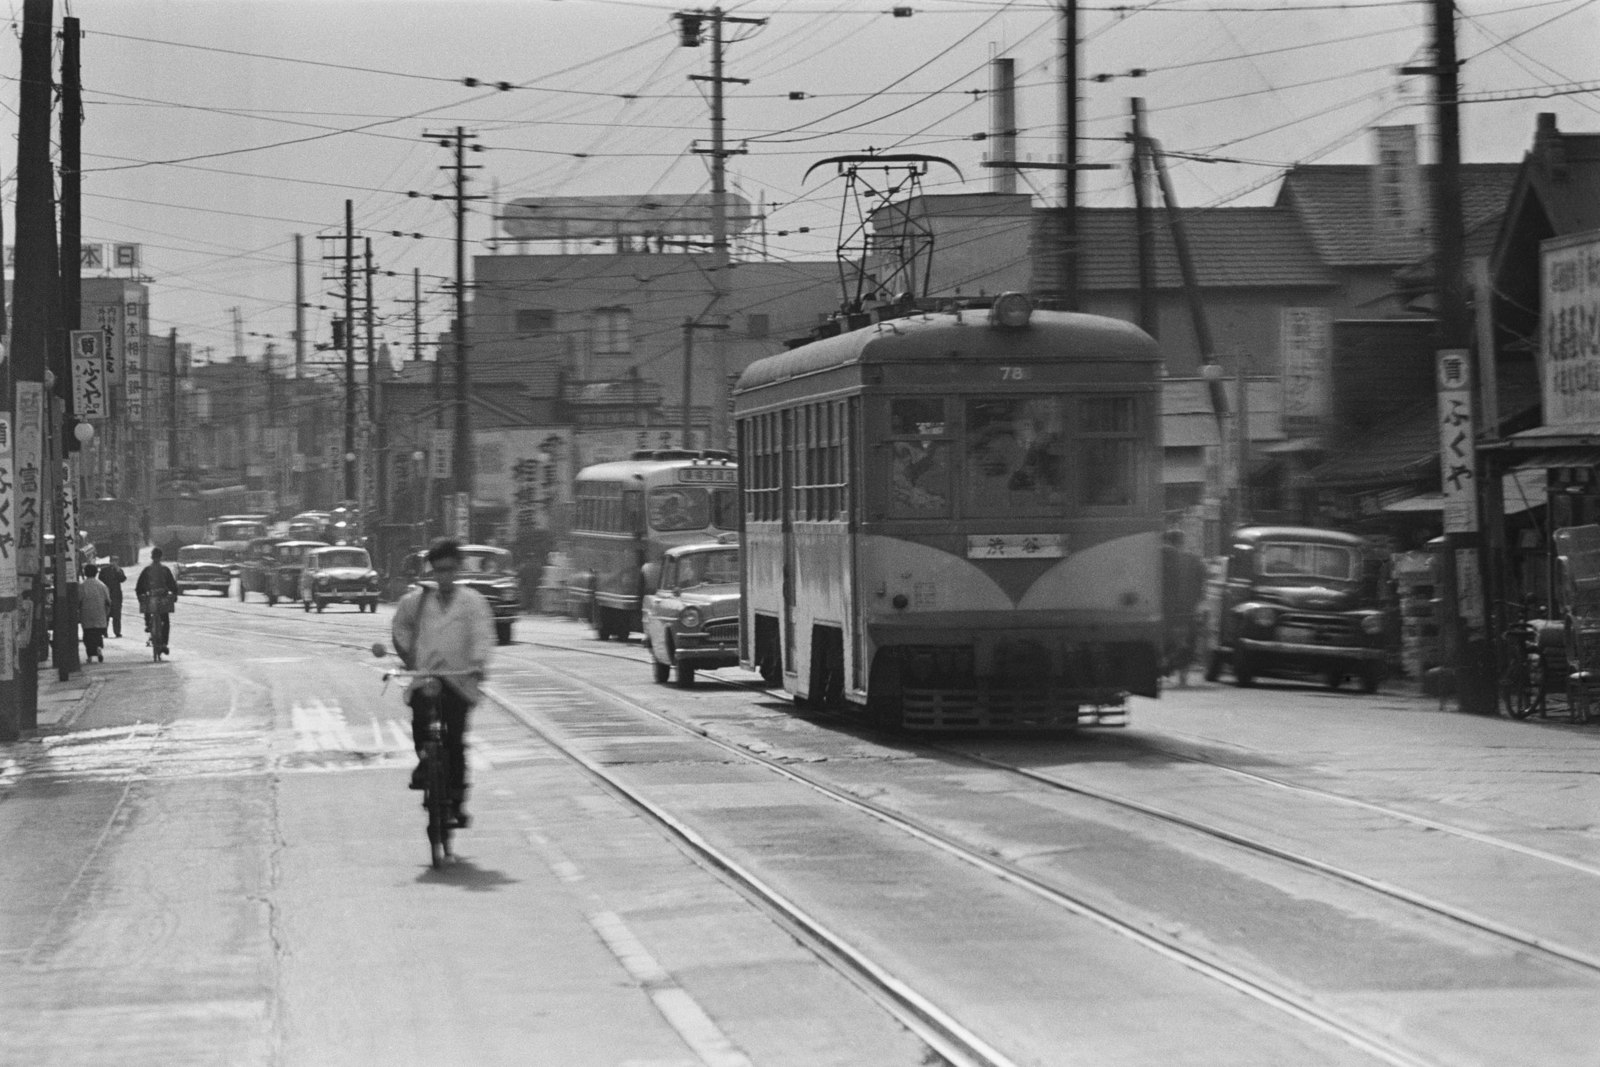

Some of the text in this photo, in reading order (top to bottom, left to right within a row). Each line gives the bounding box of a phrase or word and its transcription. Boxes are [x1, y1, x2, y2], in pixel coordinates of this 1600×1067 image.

[83, 360, 101, 404] ふくや
[999, 366, 1024, 380] 78
[1444, 399, 1472, 491] ふくや
[986, 537, 1040, 555] 渋谷
